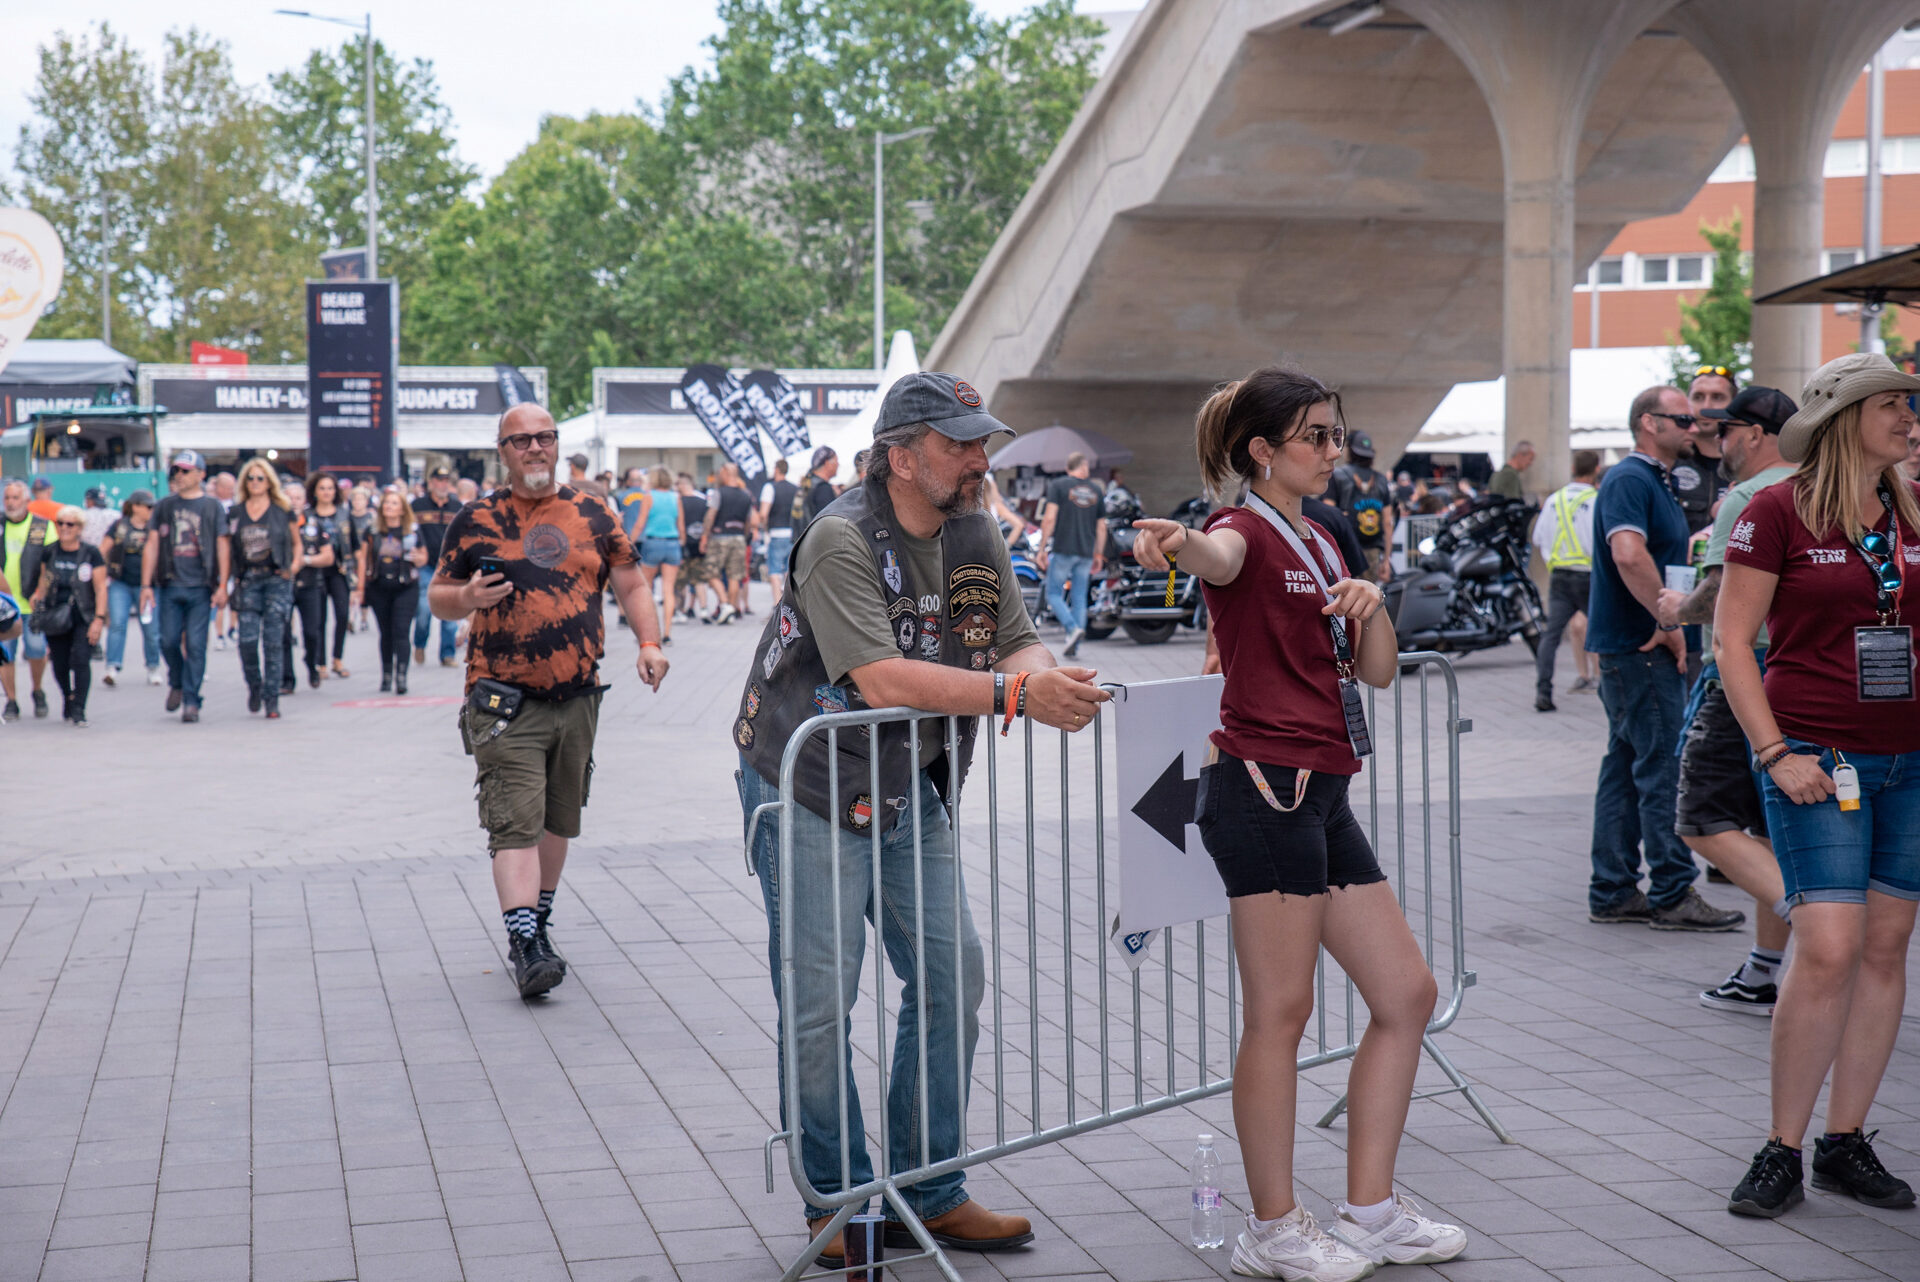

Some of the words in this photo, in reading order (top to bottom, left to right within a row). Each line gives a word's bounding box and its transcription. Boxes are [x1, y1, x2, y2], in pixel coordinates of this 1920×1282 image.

[321, 292, 364, 308] DEALER
[321, 309, 366, 325] VILLAGE
[1811, 554, 1847, 563] TEAM
[952, 569, 997, 582] PHOTOGRAPHER
[1285, 582, 1317, 594] TEAM
